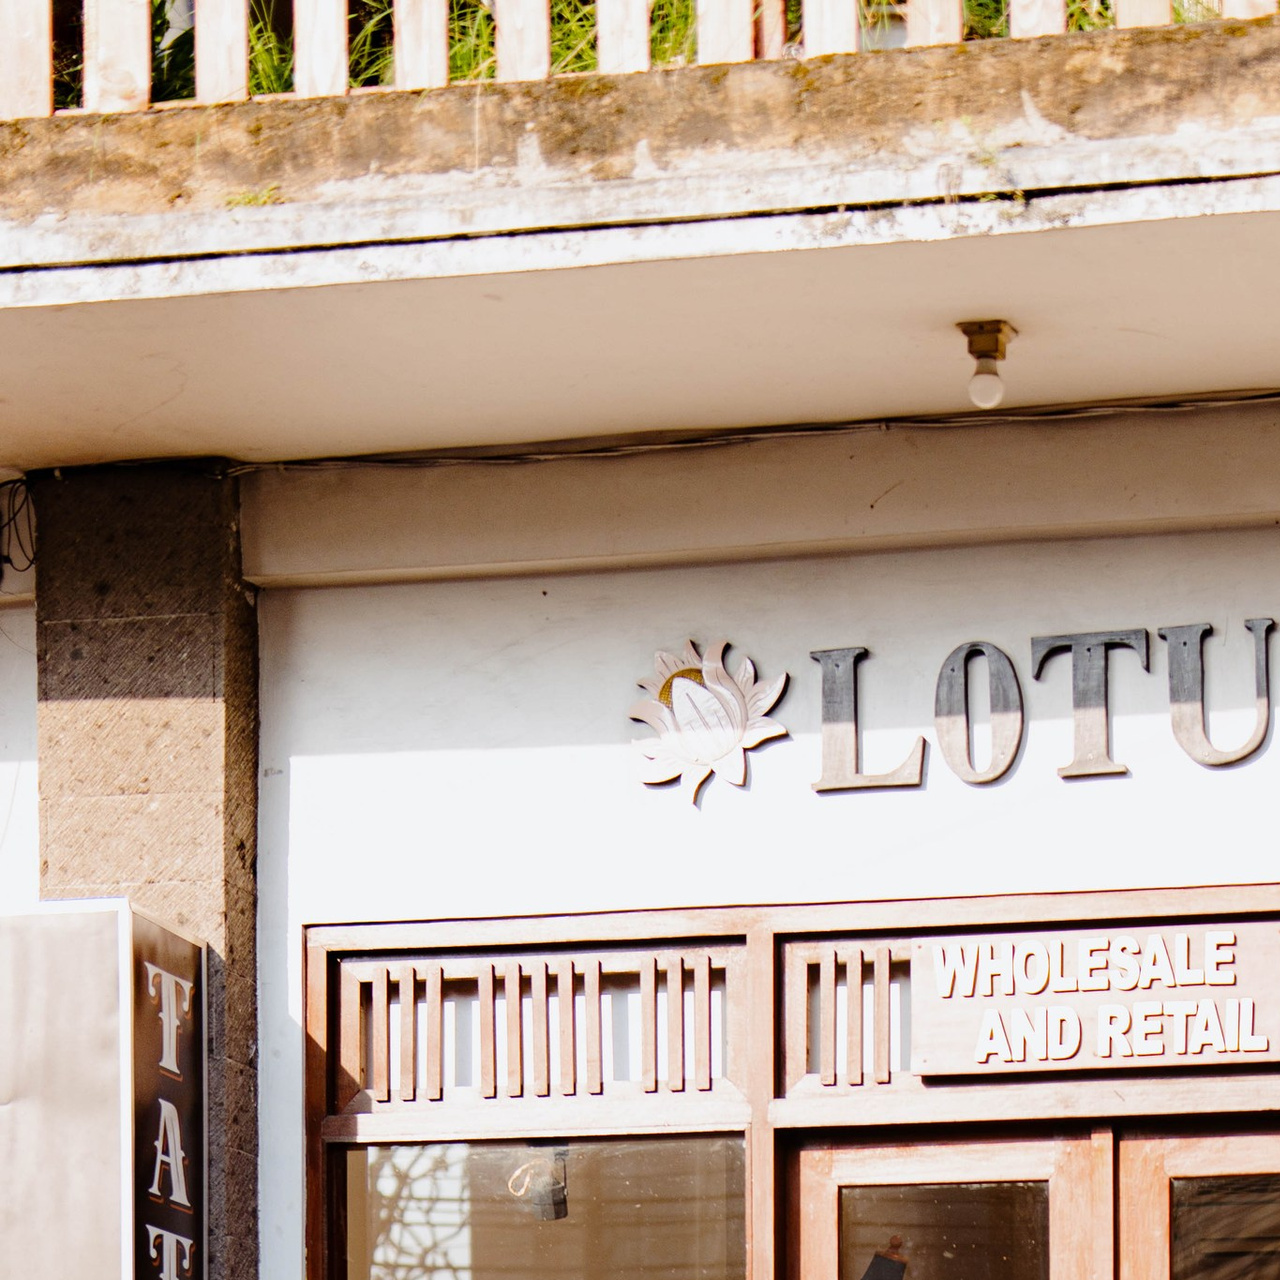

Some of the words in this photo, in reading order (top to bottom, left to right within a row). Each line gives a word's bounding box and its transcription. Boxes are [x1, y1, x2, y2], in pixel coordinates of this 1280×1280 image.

[932, 929, 1238, 1000] WHOLESALE
[975, 1004, 1081, 1064] AND
[1096, 997, 1270, 1059] RETAIL
